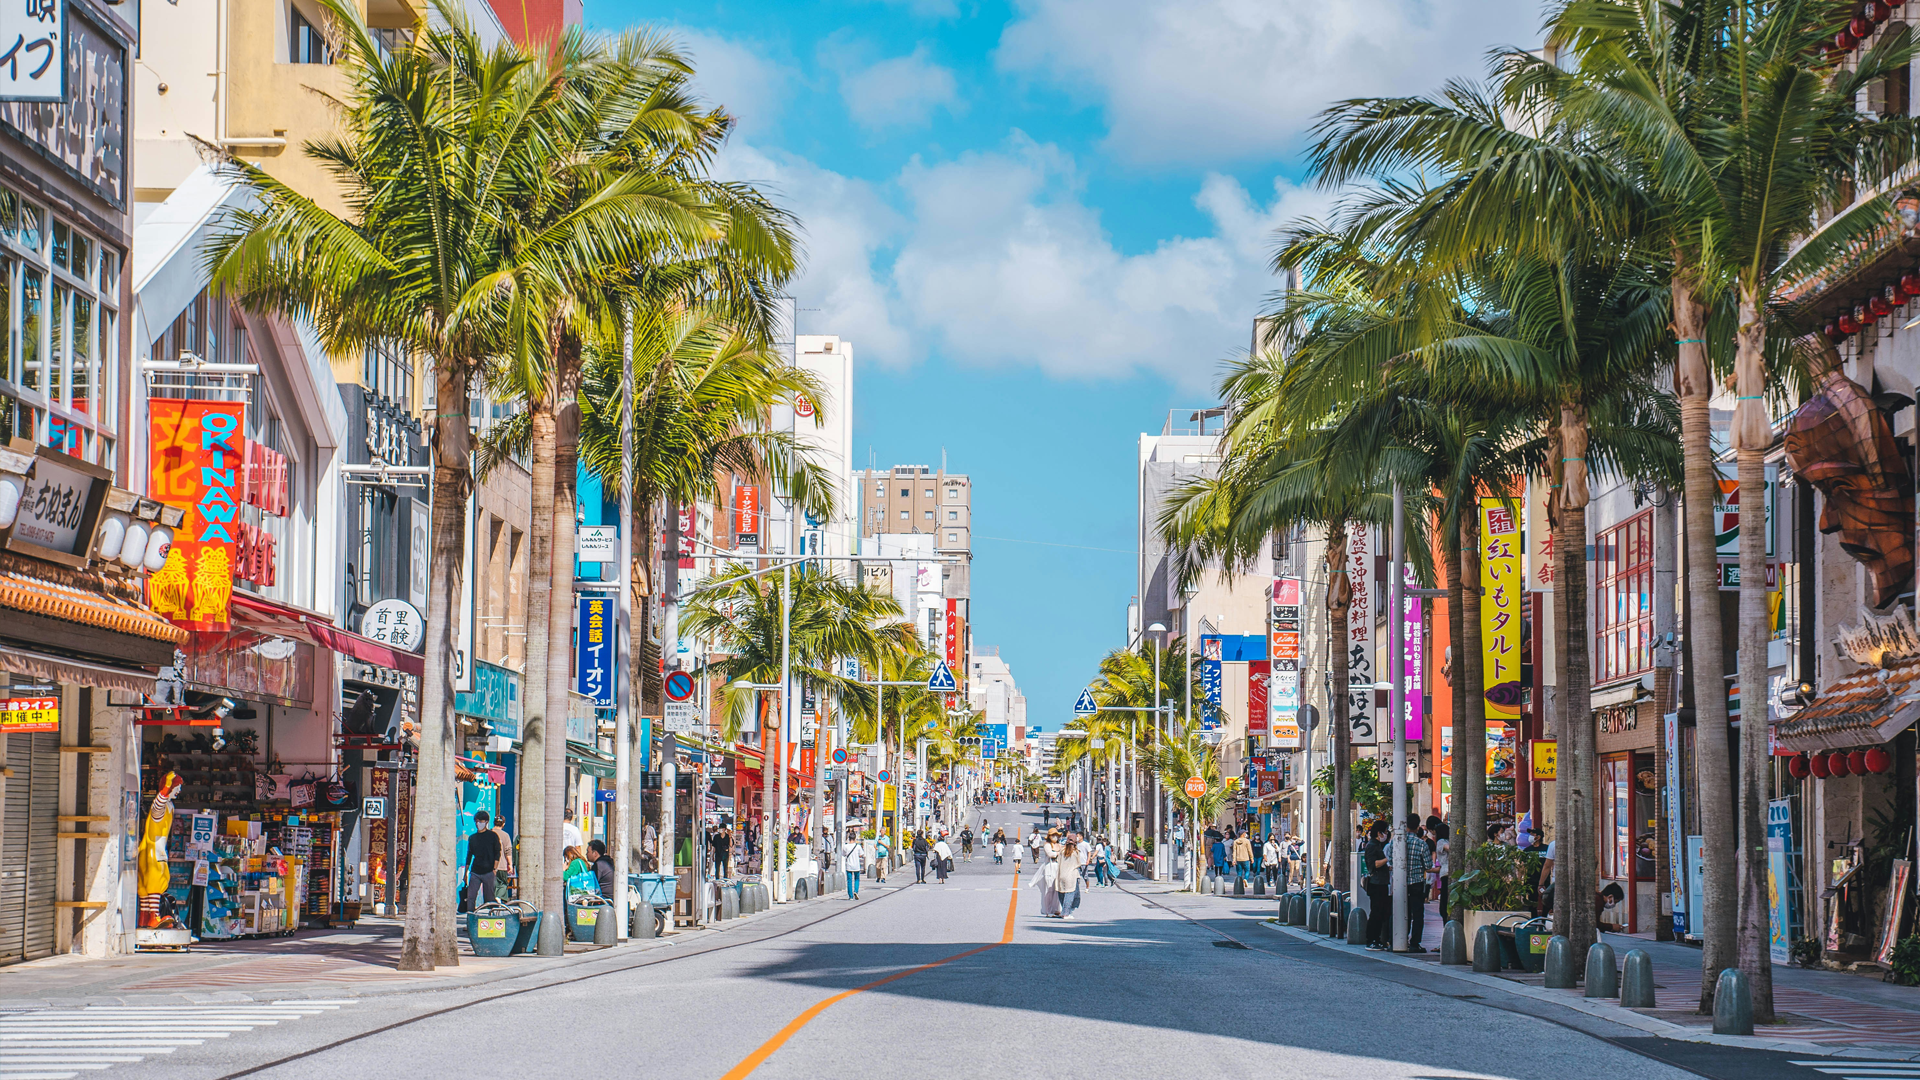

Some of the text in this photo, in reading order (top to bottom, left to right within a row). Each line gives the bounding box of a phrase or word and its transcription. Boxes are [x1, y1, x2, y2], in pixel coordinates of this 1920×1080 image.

[799, 399, 812, 412] 福
[196, 412, 239, 543] OKINAWA
[35, 479, 82, 531] ちぬまん
[1489, 509, 1515, 533] 元祖
[1350, 523, 1369, 642] 泡盛と沖縄地料理
[375, 607, 409, 626] 首里
[588, 600, 604, 643] 英会話
[1486, 538, 1515, 680] 紅いもタルト
[586, 643, 604, 698] イーオン
[1187, 783, 1205, 792] 消火栓
[1535, 766, 1557, 775] ちんす
